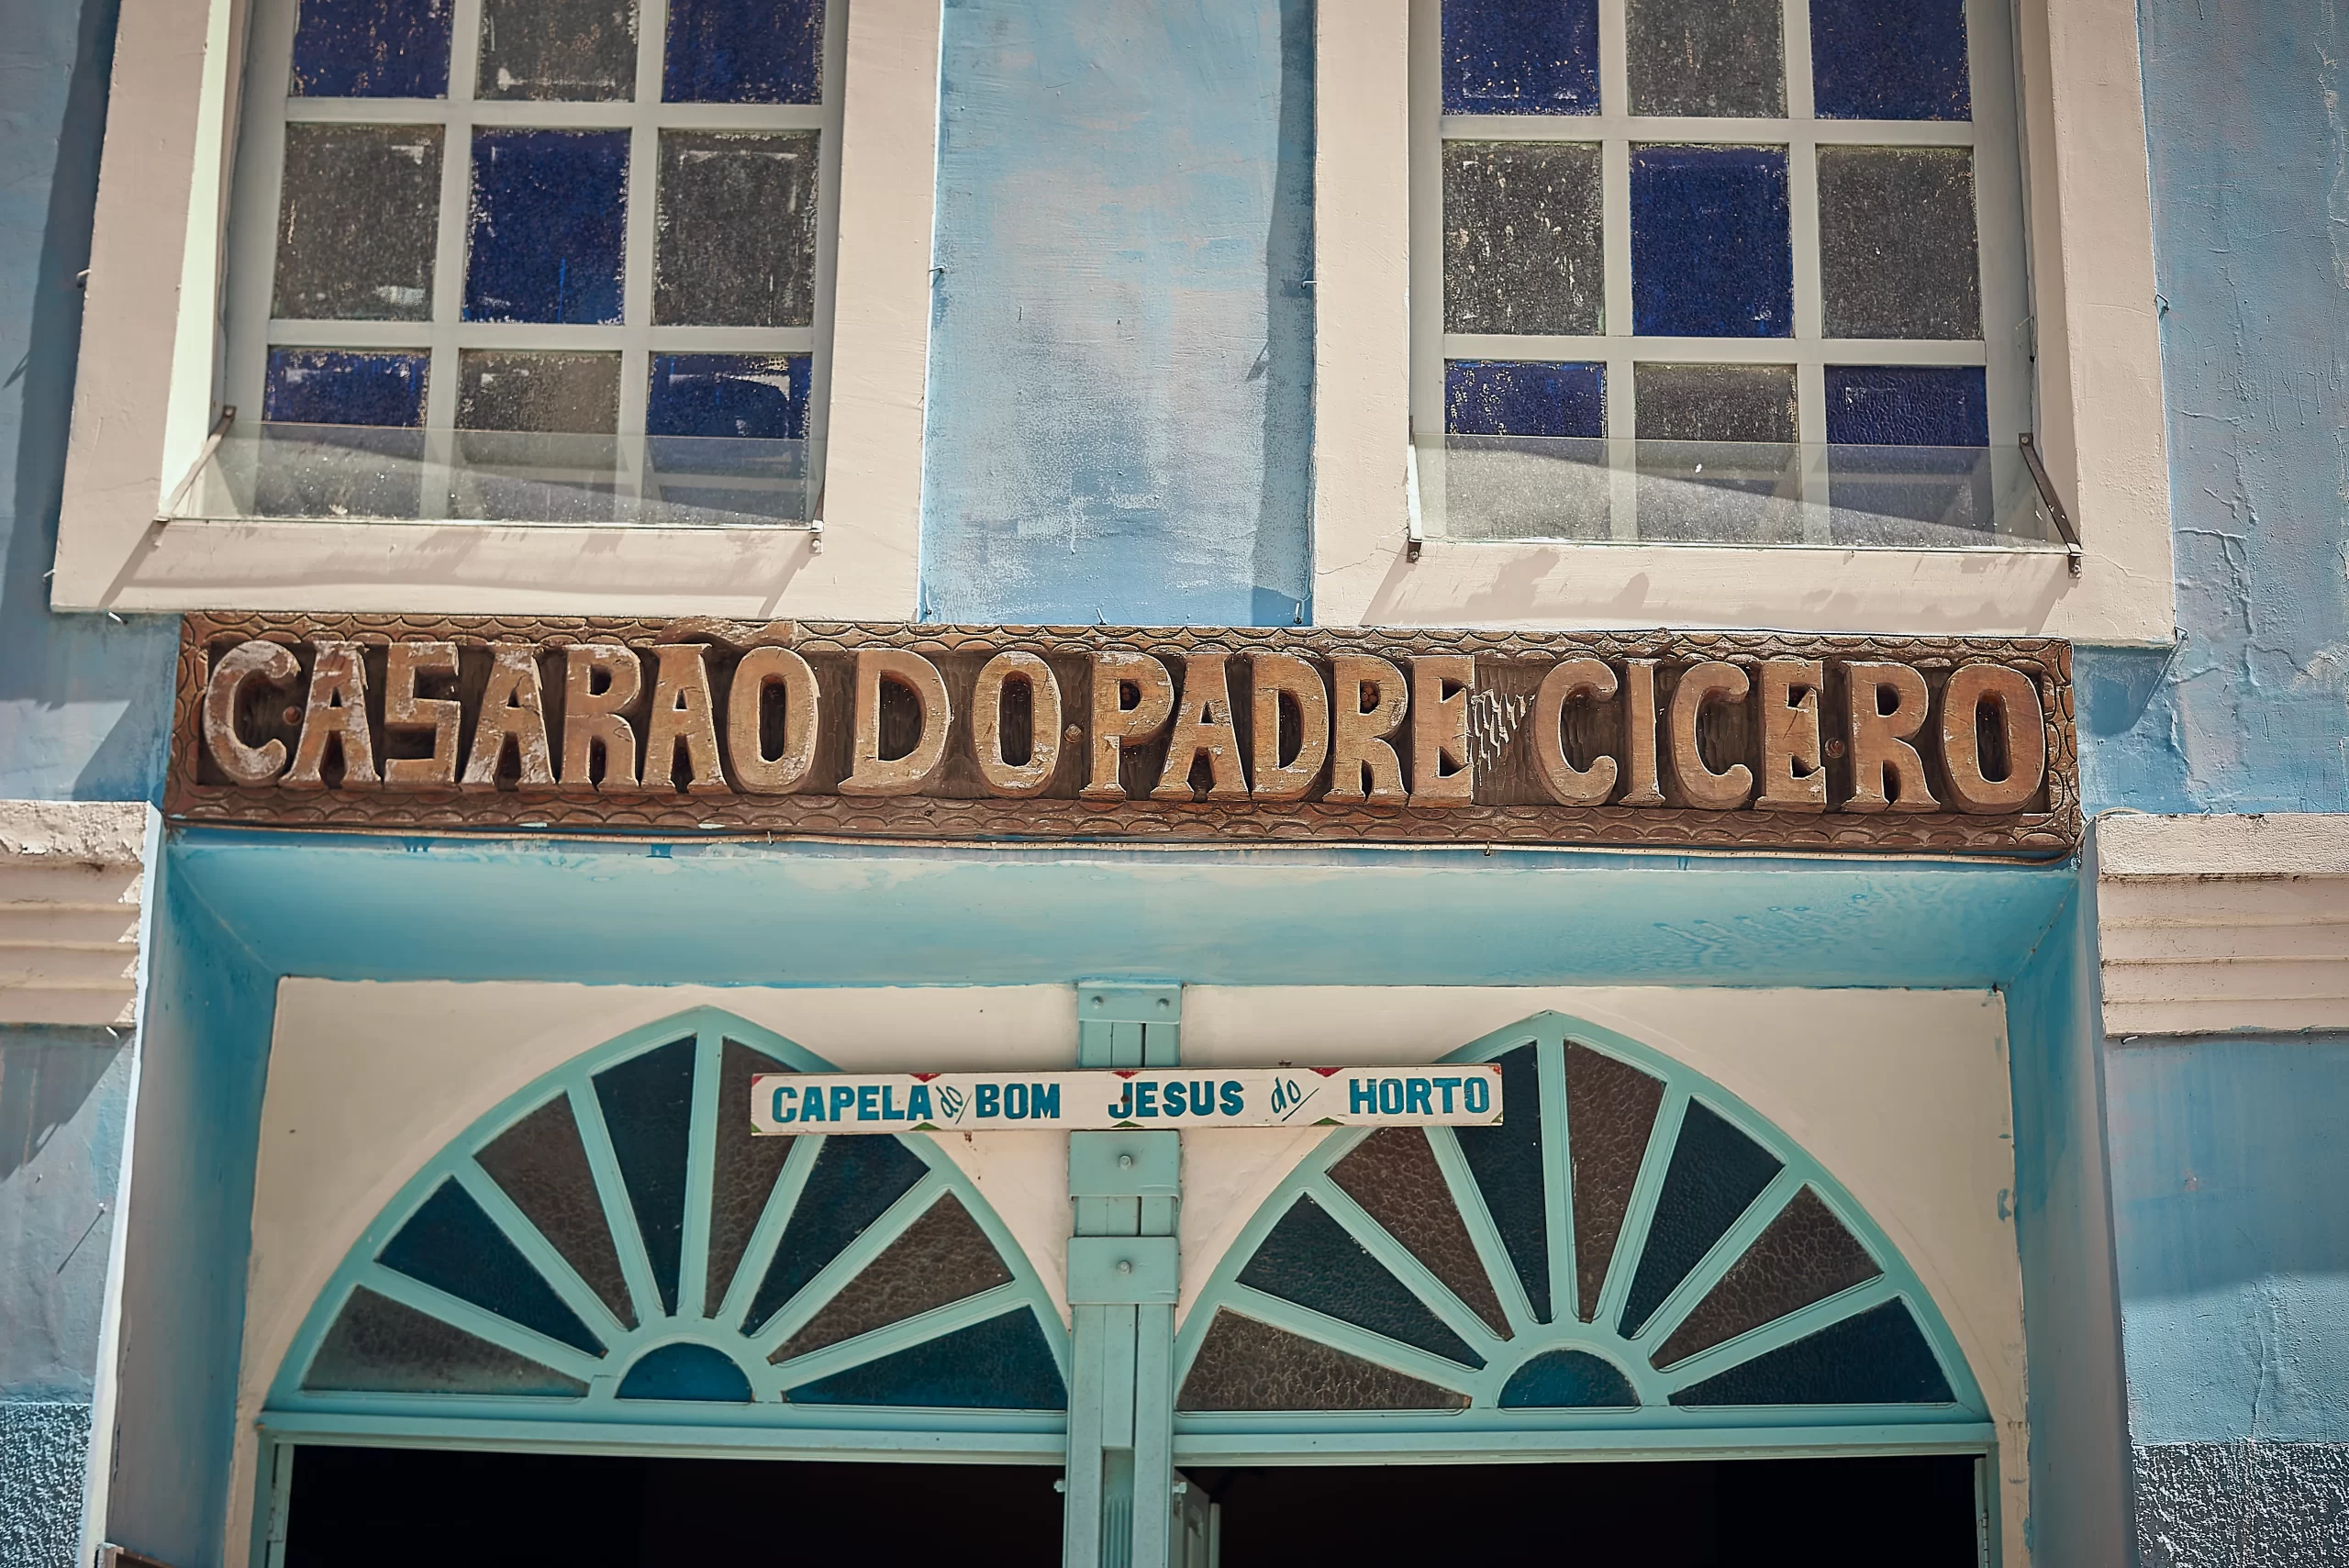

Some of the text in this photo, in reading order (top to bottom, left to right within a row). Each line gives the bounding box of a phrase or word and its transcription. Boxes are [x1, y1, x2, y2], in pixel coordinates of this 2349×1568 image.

[837, 649, 1063, 798] DO
[1077, 651, 1475, 808] PADRE
[1531, 657, 2047, 815] CICERO
[772, 1084, 934, 1124] CAPELA
[975, 1083, 1061, 1120] BOM
[1108, 1080, 1244, 1119] JESUS
[1349, 1077, 1490, 1116] HORTO
